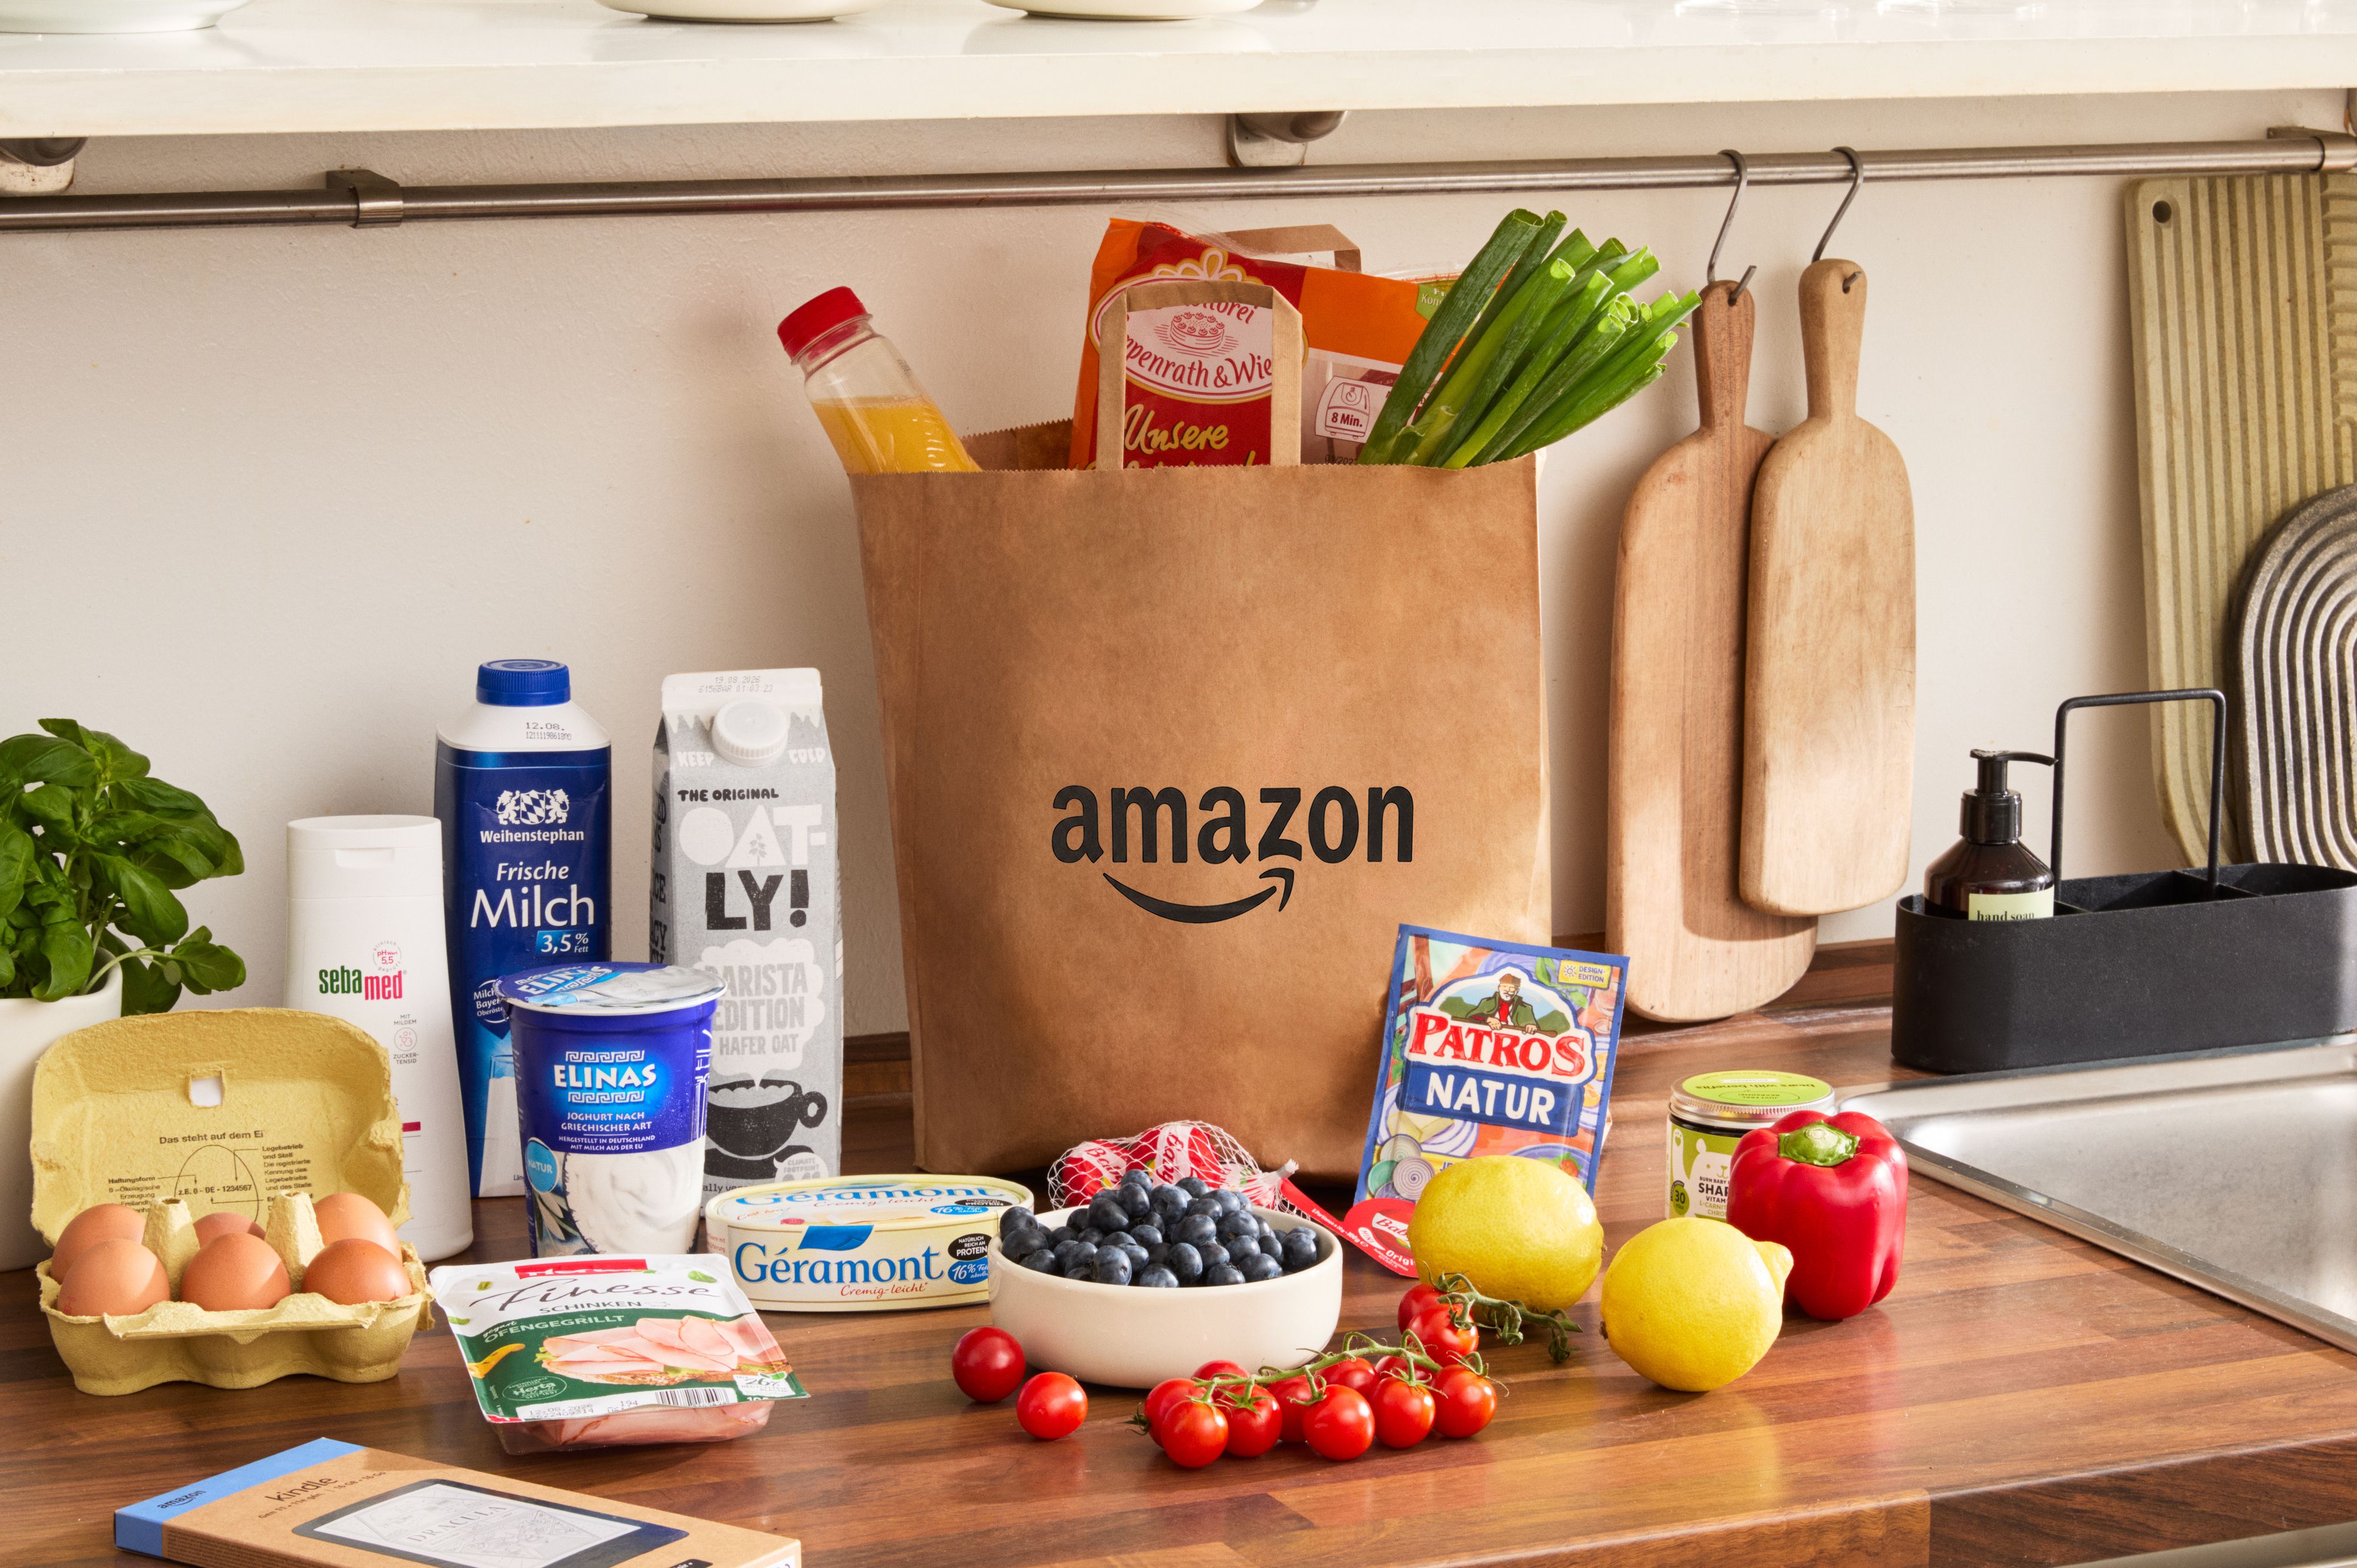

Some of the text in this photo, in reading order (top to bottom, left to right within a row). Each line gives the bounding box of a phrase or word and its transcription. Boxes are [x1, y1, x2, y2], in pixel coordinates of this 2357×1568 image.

[1214, 365, 1233, 388] &
[1331, 412, 1362, 427] 8 Min.
[1124, 404, 1229, 455] Unsere
[526, 722, 565, 731] 12.08.
[677, 747, 826, 767] KEEP COLD
[678, 788, 779, 802] THE ORIGINAL
[1051, 785, 1414, 864] amazon
[480, 830, 585, 844] Weihenstephan
[497, 860, 569, 881] Frische
[471, 884, 595, 928] Milch
[705, 869, 809, 931] LY!
[542, 932, 589, 954] 3,5 %
[377, 949, 387, 958] pH
[381, 956, 394, 965] 5,5
[1578, 973, 1604, 983] EDITION
[713, 996, 805, 1031] EDITION
[719, 1034, 799, 1055] HAFER OAT
[1409, 1012, 1585, 1077] PATROS
[554, 1063, 657, 1089] ELINAS
[1425, 1071, 1556, 1125] NATUR
[567, 1111, 645, 1121] JOGHURT NACH
[561, 1121, 652, 1132] GRIECHISCHER ART
[181, 1134, 207, 1142] steht
[609, 1135, 655, 1144] DEUTSCHLAND
[262, 1144, 303, 1152] Legebetrieb
[276, 1159, 311, 1167] registrierte
[527, 1158, 553, 1174] NATUR
[265, 1175, 308, 1183] Legebetriebs
[735, 1187, 1004, 1206] Géramont
[1675, 1190, 1685, 1204] 30
[1375, 1218, 1408, 1236] Bab
[959, 1235, 984, 1243] NATÜRLICH
[956, 1246, 988, 1256] PROTEIN
[1386, 1249, 1415, 1266] Origi
[735, 1242, 945, 1284] Géramont
[469, 1278, 721, 1312] Finesse
[540, 1300, 642, 1313] SCHINKEN
[484, 1315, 625, 1343] OFENGEGRILLT
[157, 1489, 206, 1509] amazon
[265, 1478, 338, 1502] kindle
[407, 1506, 507, 1543] DRACULA
